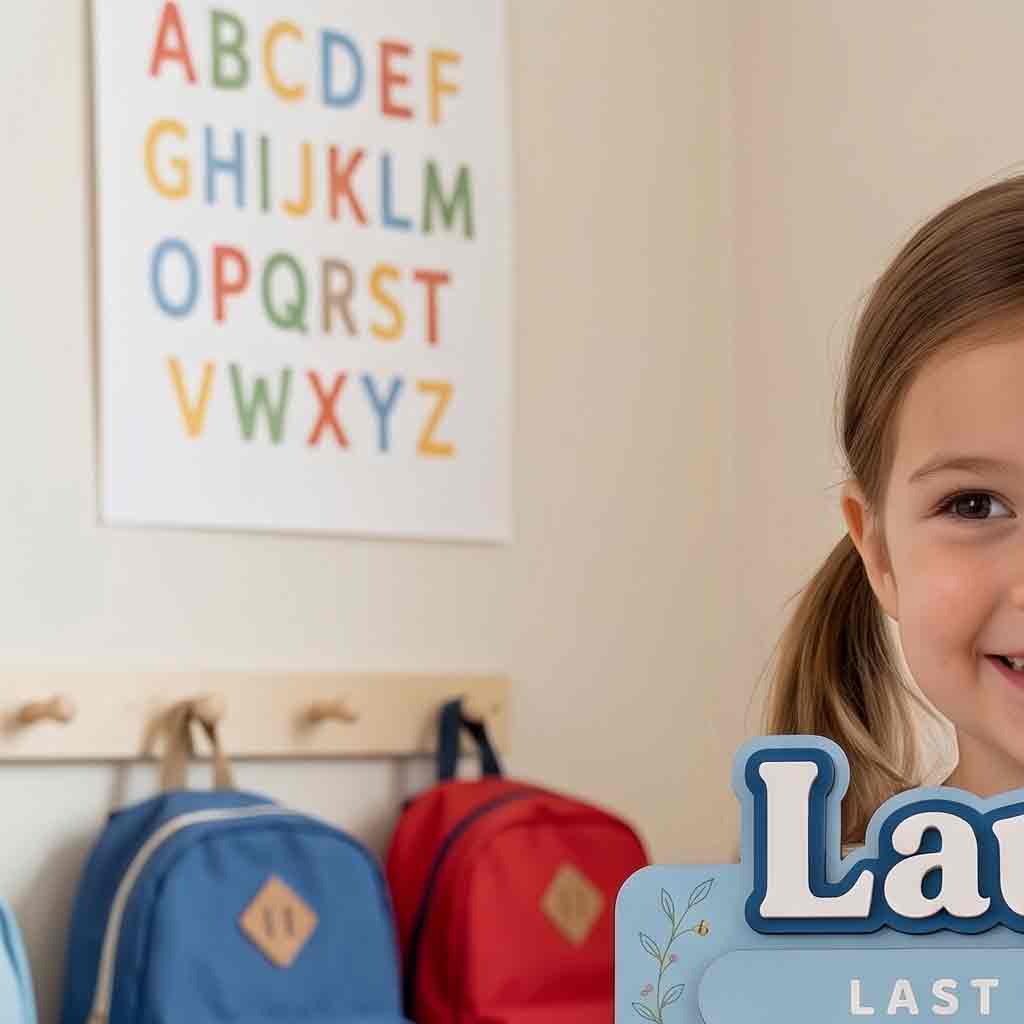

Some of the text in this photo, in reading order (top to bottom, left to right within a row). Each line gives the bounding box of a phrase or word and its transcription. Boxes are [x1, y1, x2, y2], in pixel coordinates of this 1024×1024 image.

[148, 1, 463, 127] ABCDEF
[143, 117, 476, 241] GHIJKLM
[149, 236, 453, 347] OPQRST
[166, 354, 457, 459] VWXYZ
[849, 978, 1001, 1017] LAST
